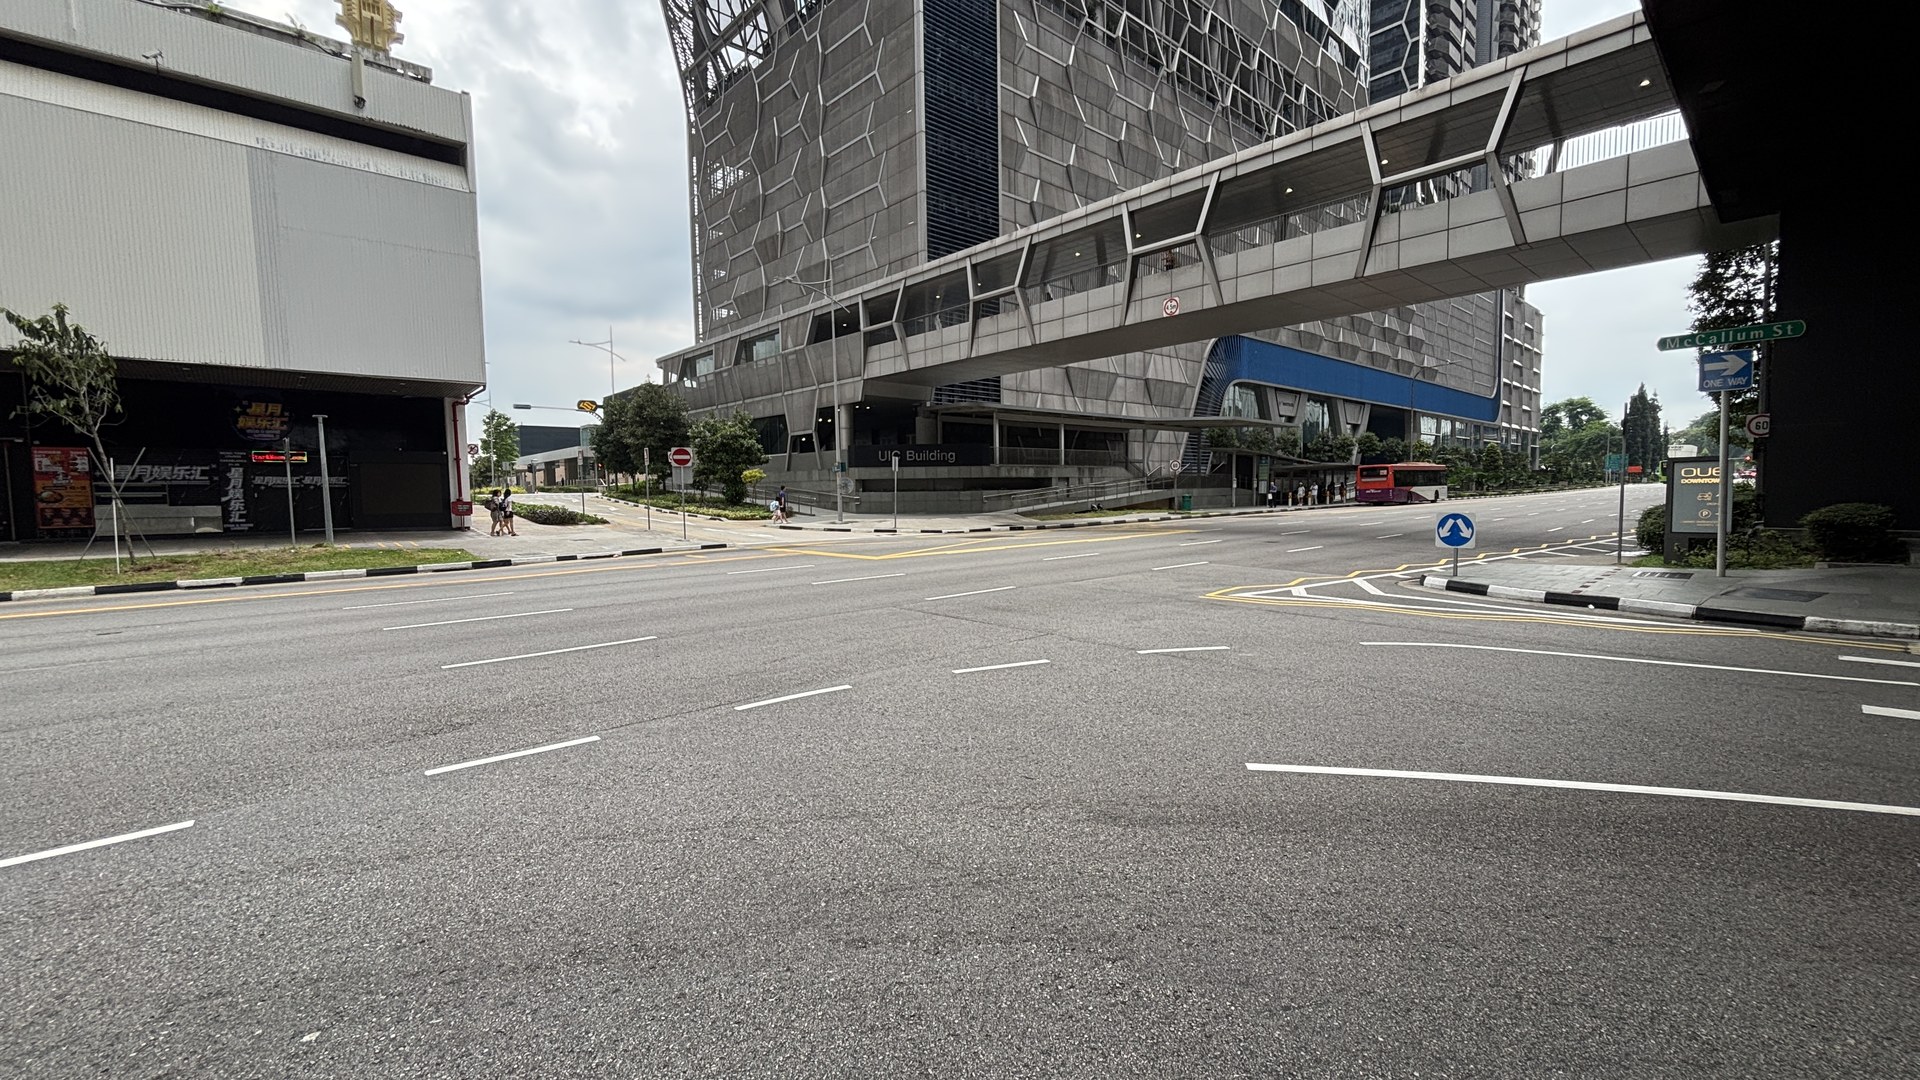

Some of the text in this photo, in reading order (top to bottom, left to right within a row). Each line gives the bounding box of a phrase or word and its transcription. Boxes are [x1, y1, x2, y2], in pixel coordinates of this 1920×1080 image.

[1665, 324, 1794, 350] McCallum St
[1703, 377, 1748, 388] ONE WAY
[1755, 421, 1769, 430] 60
[906, 450, 956, 463] Building
[114, 464, 210, 483] 星月娱乐汇
[220, 467, 247, 522] 星月娱乐汇
